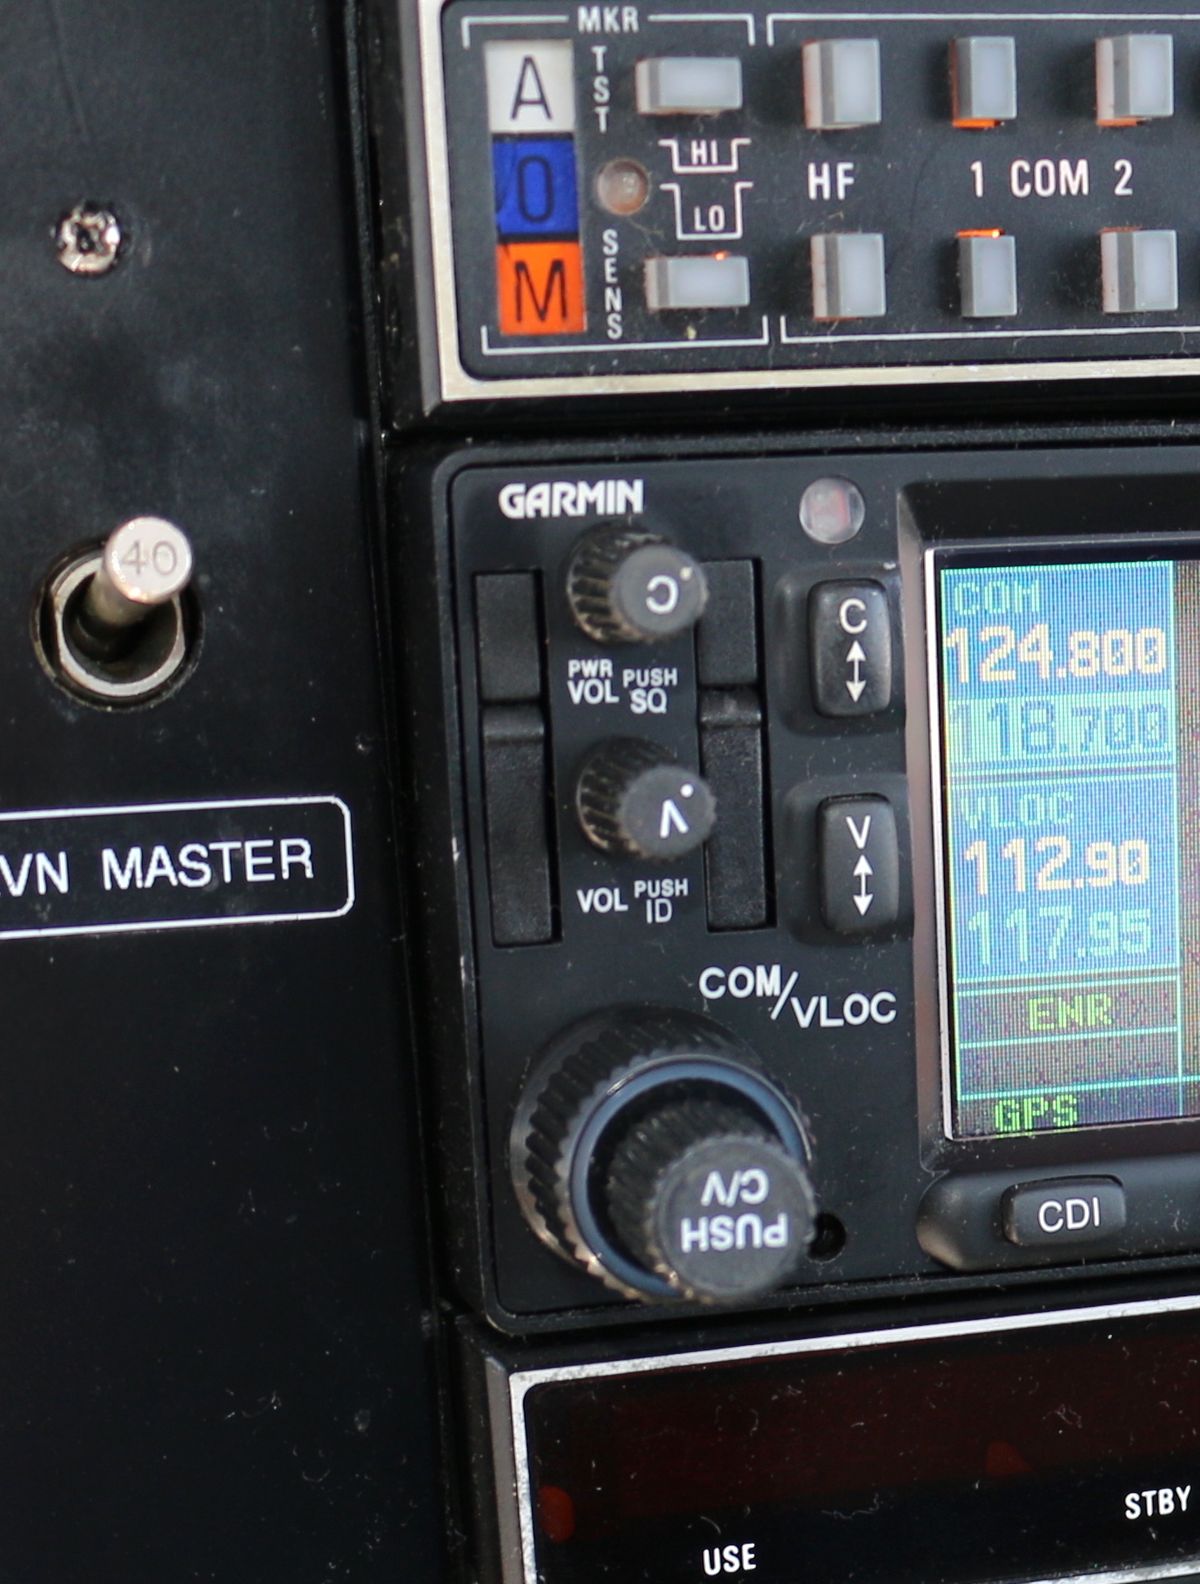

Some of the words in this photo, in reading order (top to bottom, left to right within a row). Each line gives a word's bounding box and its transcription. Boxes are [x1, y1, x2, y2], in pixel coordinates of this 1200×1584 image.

[578, 6, 640, 34] MKR
[509, 55, 553, 121] A
[591, 45, 610, 133] TST
[690, 139, 720, 166] HI
[808, 162, 855, 199] HF
[970, 161, 984, 198] 1
[1010, 161, 1089, 197] COM
[1114, 160, 1134, 196] 2
[692, 205, 726, 232] LO
[514, 259, 569, 323] M
[600, 229, 624, 340] SENS
[499, 479, 644, 519] GARMIN
[119, 541, 178, 576] 40
[839, 598, 867, 635] C
[953, 580, 1041, 617] COM
[568, 660, 612, 679] PWR
[944, 624, 1167, 684] 124.800
[567, 679, 619, 706] VOL
[622, 668, 678, 689] PUSH
[630, 690, 667, 715] SQ
[961, 791, 1075, 830] VLOC
[845, 815, 872, 849] V
[0, 850, 69, 896] VN
[102, 839, 314, 891] MASTER
[963, 836, 1150, 897] 112.90
[576, 888, 628, 913] VOL
[634, 879, 688, 898] PUSH
[647, 899, 672, 924] ID
[966, 906, 1153, 966] 117.95
[1028, 992, 1113, 1032] ENR
[994, 1093, 1078, 1132] GPS
[701, 1169, 769, 1207] C/V
[681, 1214, 788, 1252] PUSH
[1038, 1198, 1100, 1234] CDI
[1124, 1485, 1191, 1520] STBY
[703, 1543, 756, 1576] USE
